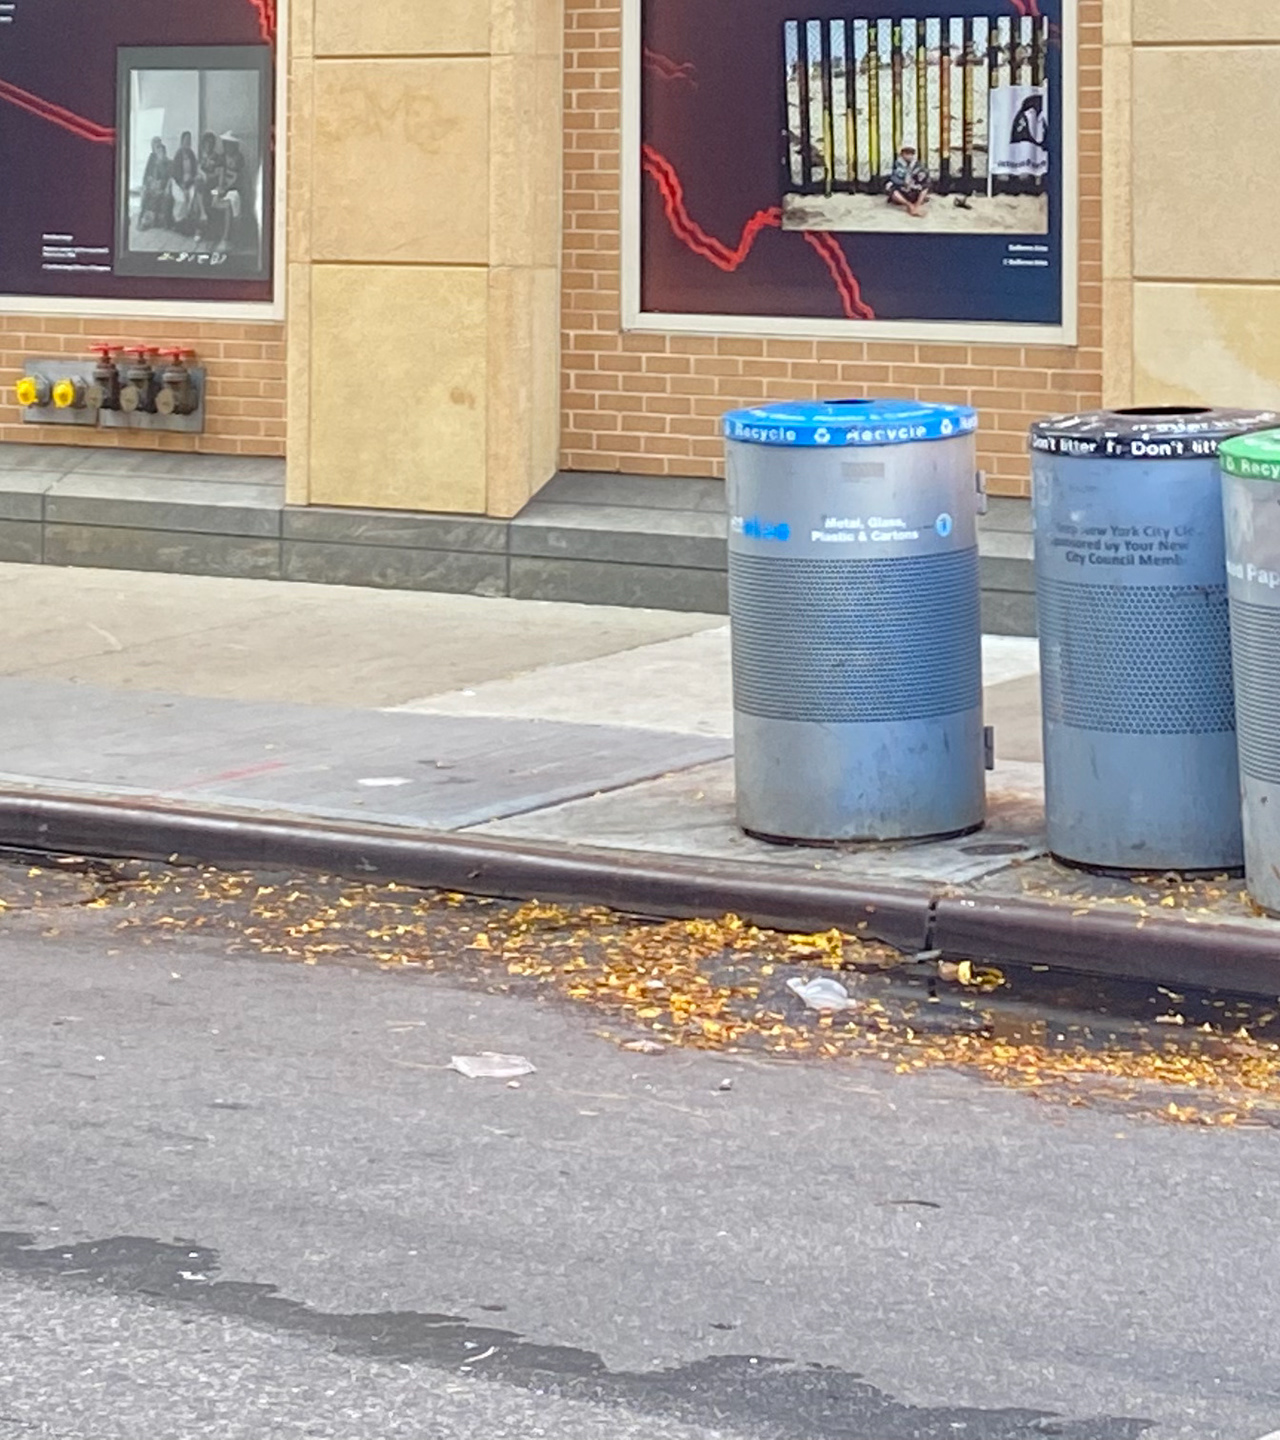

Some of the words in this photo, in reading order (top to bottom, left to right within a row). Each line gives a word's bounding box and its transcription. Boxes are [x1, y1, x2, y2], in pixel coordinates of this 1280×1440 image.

[734, 424, 797, 442] Recycle
[1131, 440, 1184, 456] Don't
[824, 517, 865, 530] Metal,
[811, 530, 856, 542] Plastic
[858, 531, 867, 542] &
[870, 530, 920, 541] Cartons
[1109, 525, 1140, 537] York
[1144, 525, 1171, 539] City
[1123, 539, 1154, 552] Your
[1158, 540, 1188, 551] New
[1065, 551, 1085, 566] City
[1088, 551, 1135, 566] Council
